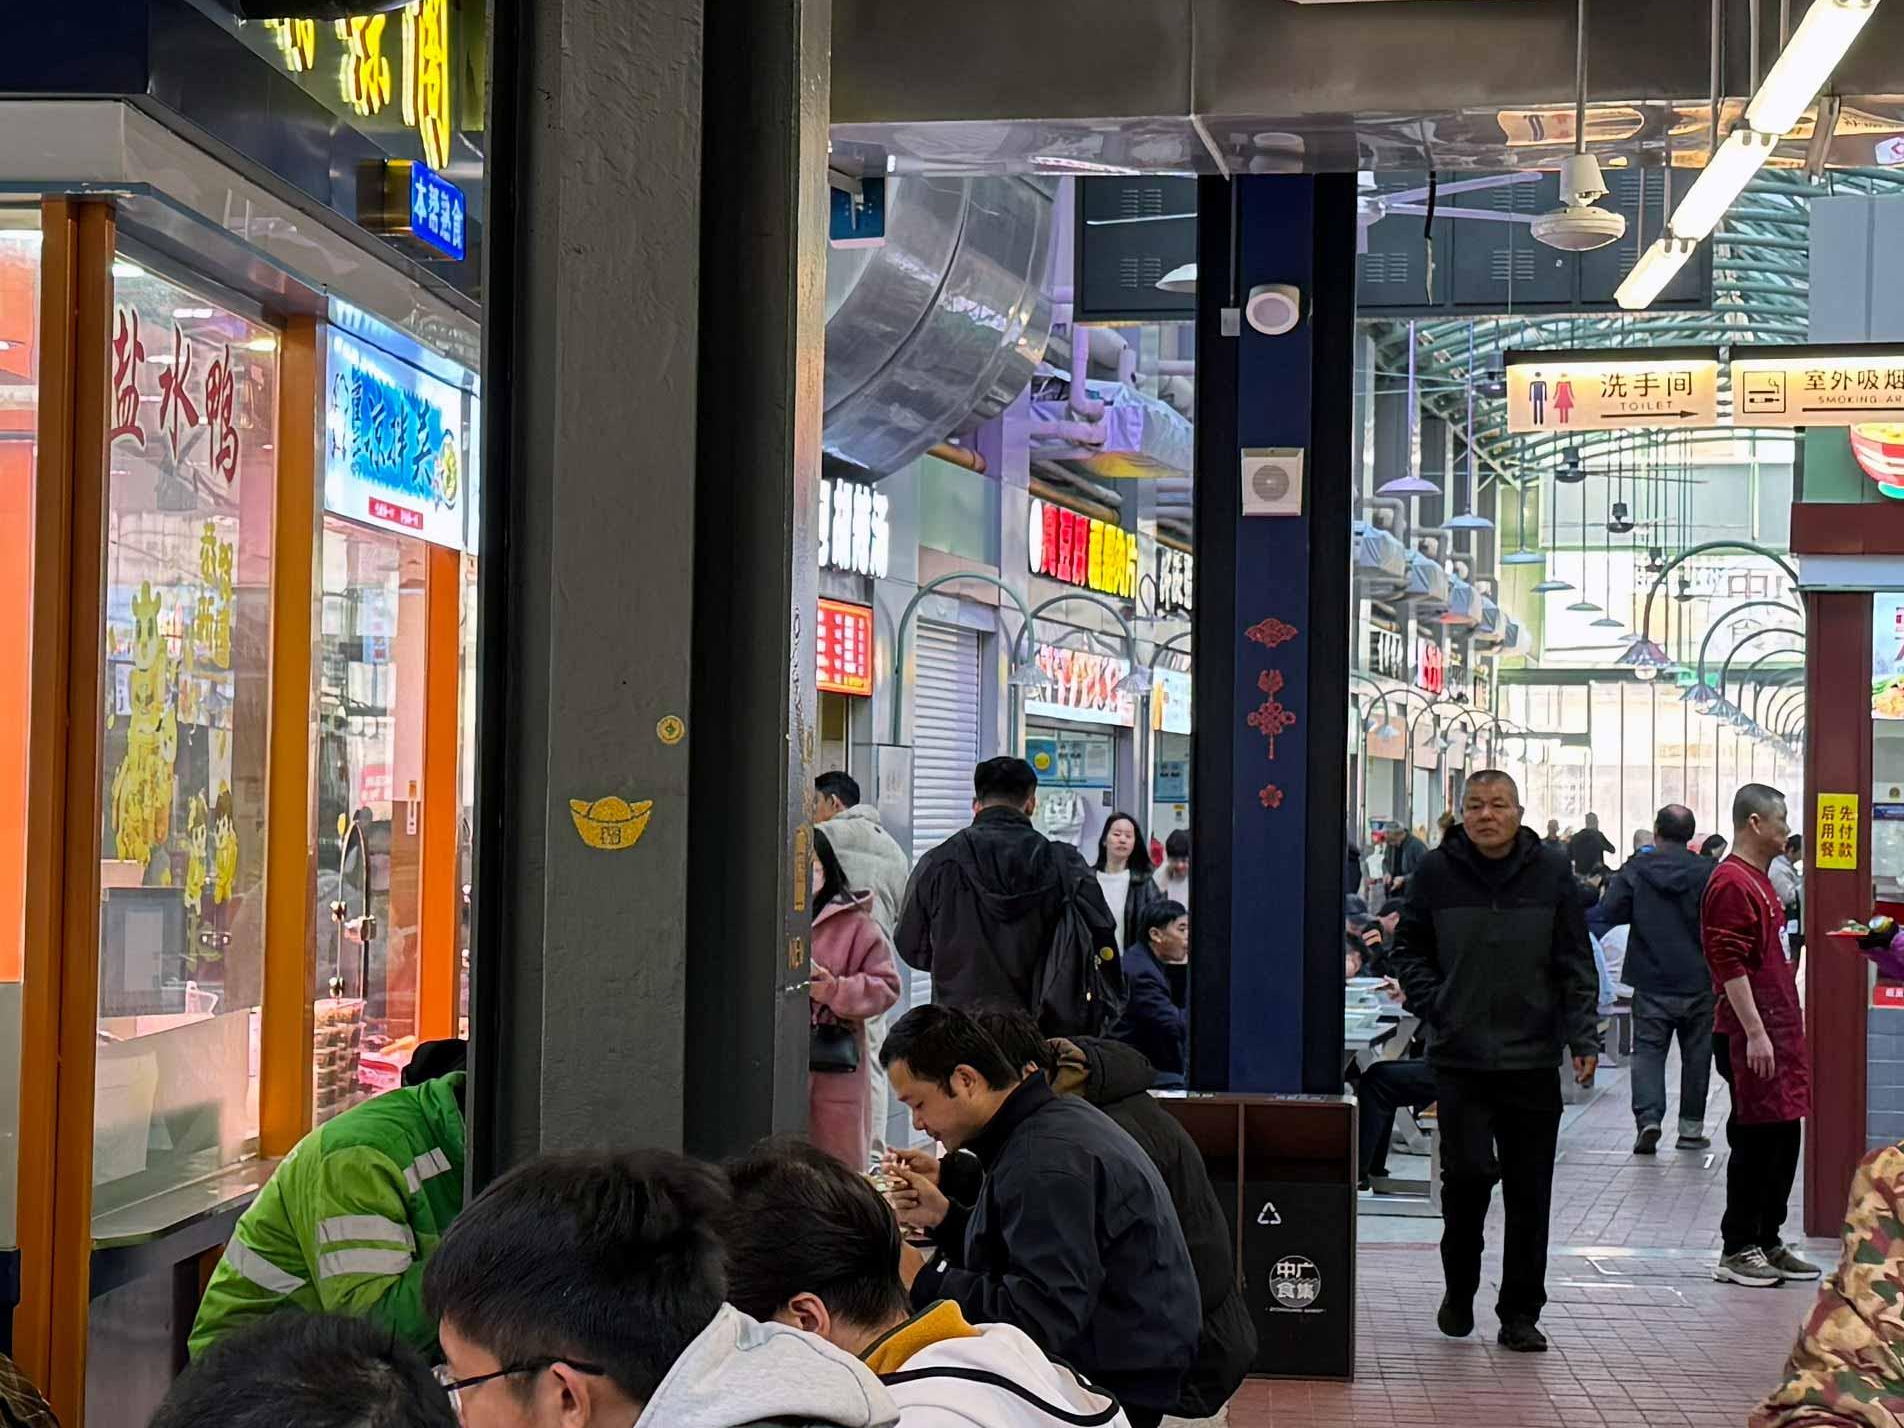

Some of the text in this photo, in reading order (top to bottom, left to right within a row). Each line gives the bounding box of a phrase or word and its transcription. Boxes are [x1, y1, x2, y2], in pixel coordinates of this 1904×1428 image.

[109, 303, 241, 483] 盐水鸭
[1600, 370, 1693, 399] 洗手间
[1619, 401, 1673, 412] TOILET
[1817, 395, 1879, 406] SMOKING
[1820, 805, 1835, 859] 后用餐
[1838, 805, 1855, 860] 先付款
[1276, 1261, 1315, 1278] 中广
